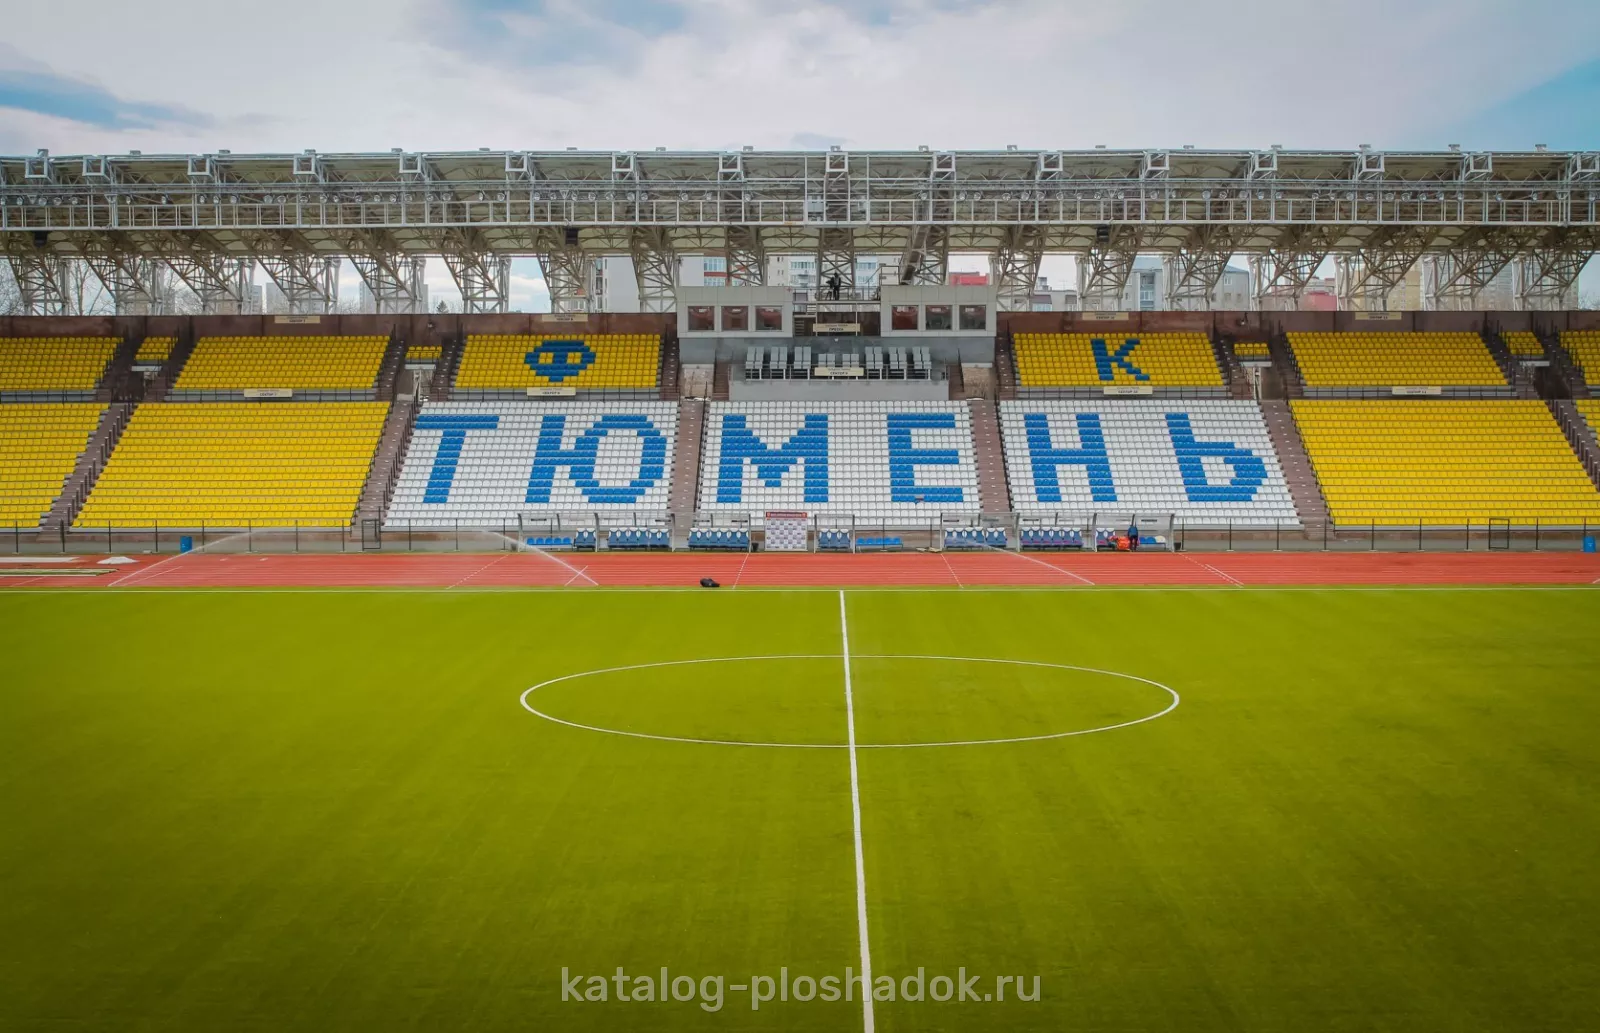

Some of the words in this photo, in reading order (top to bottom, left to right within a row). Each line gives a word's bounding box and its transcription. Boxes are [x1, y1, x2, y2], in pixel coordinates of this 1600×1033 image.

[526, 341, 596, 382] Ф
[1092, 340, 1150, 381] К
[416, 414, 1268, 503] ТЮМЕНЬ
